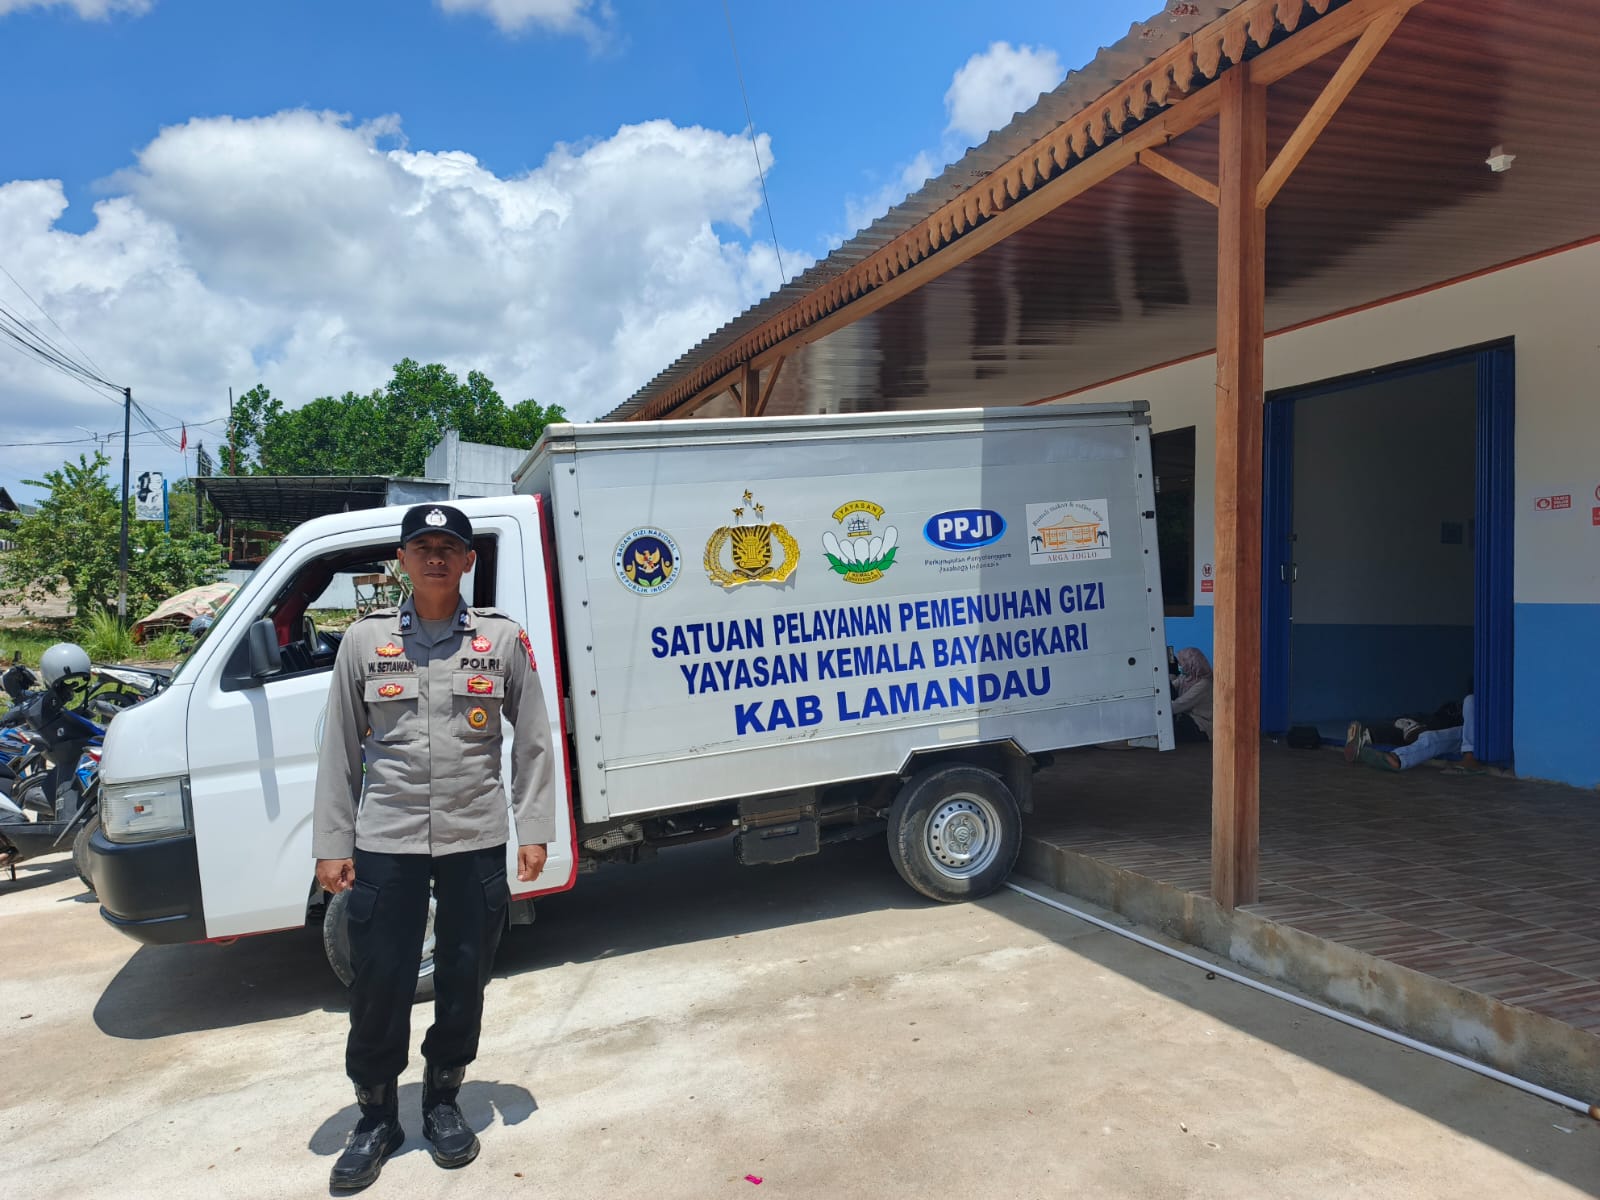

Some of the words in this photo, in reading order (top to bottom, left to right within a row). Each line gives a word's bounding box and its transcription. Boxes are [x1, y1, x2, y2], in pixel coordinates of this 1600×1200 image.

[839, 503, 878, 515] YAYASAN
[938, 514, 993, 541] PPJI
[617, 536, 631, 557] BADAN
[649, 530, 676, 552] NASIONAL
[1048, 554, 1069, 562] ARGA
[1072, 552, 1097, 560] JOGLO
[620, 571, 648, 592] REPUBLIK
[650, 567, 678, 592] INDONESIA
[651, 616, 764, 658] SATUAN
[774, 603, 892, 646] PELAYANAN
[899, 588, 1052, 632] PEMENUHAN
[1060, 582, 1105, 613] GIZI
[461, 658, 500, 671] POLRI
[680, 652, 808, 695] YAYASAN
[818, 640, 925, 680] KEMALA
[934, 622, 1089, 667] BAYANGKARI
[735, 694, 823, 735] KAB
[837, 666, 1052, 722] LAMANDAU
